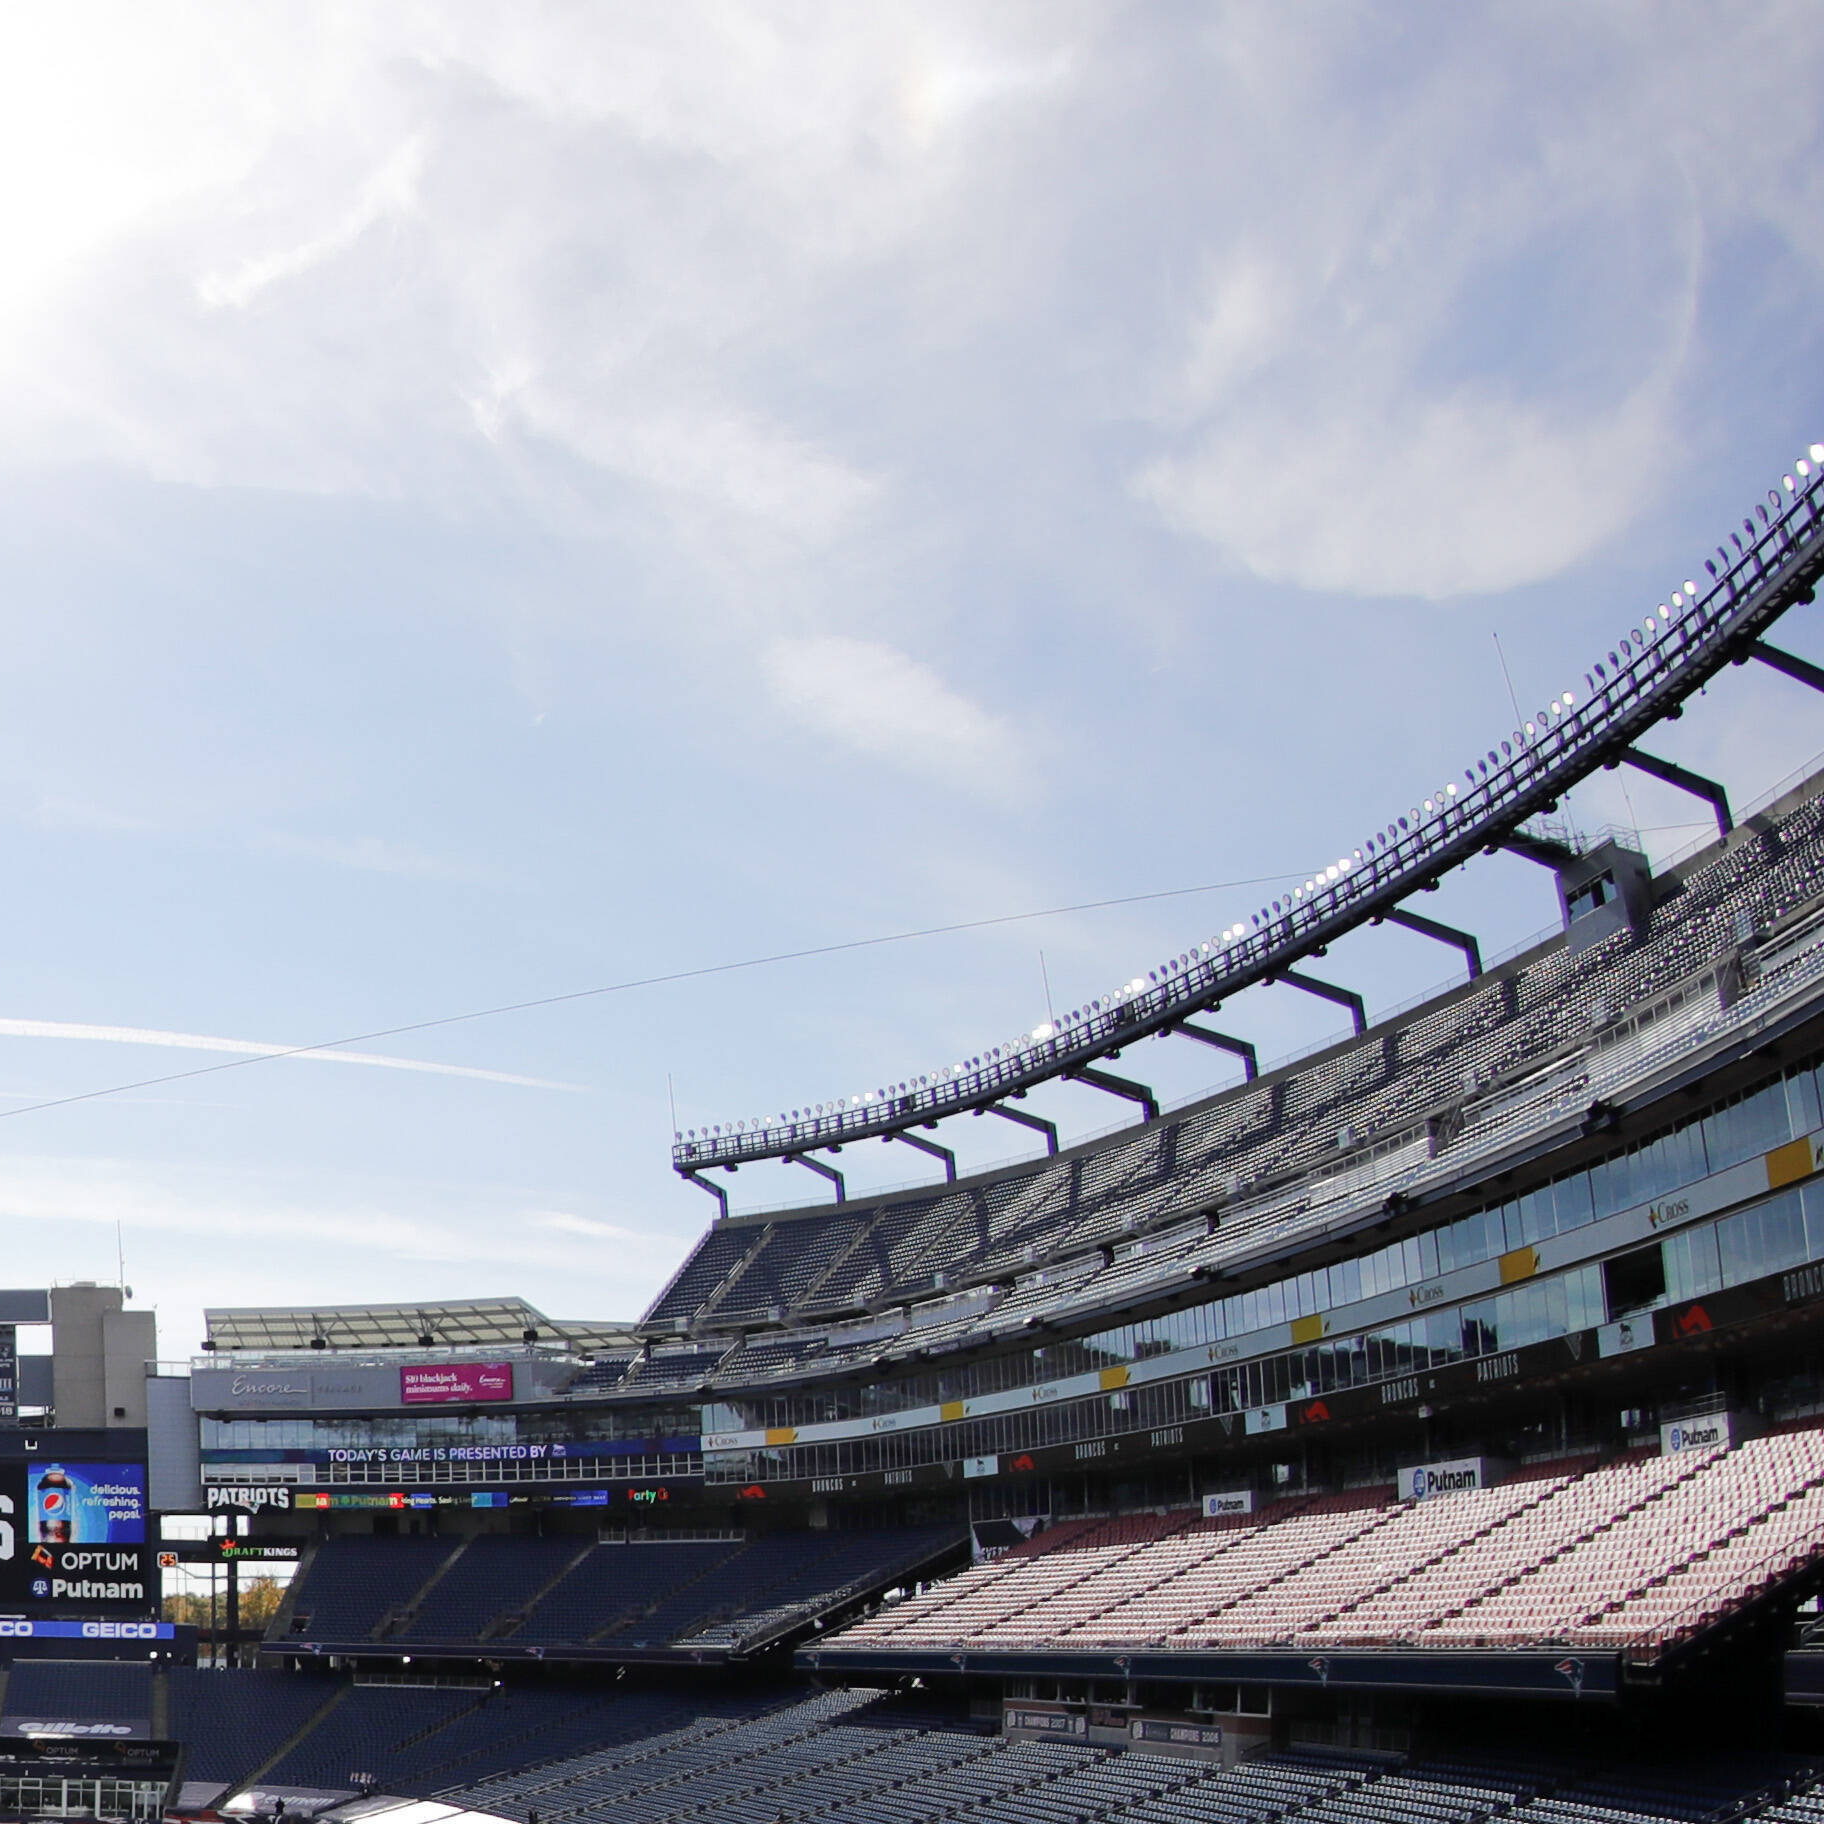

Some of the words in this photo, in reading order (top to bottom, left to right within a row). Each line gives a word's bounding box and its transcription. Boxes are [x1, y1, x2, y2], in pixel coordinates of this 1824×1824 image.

[232, 1374, 308, 1396] Encore
[1681, 1426, 1719, 1447] Putnam
[328, 1449, 387, 1462] TODAY'S
[391, 1449, 430, 1461] GAME
[433, 1448, 445, 1460] IS
[449, 1446, 526, 1460] PRESENTED
[529, 1445, 547, 1459] BY
[1427, 1469, 1476, 1493] Putnam
[90, 1484, 141, 1495] delicious.
[82, 1496, 141, 1508] refreshing.
[207, 1487, 290, 1509] PATRIOTS
[222, 1545, 297, 1558] DRAFTKINGS
[61, 1552, 138, 1571] OPTUM
[159, 1553, 176, 1567] 25
[52, 1579, 143, 1599] Putnam
[82, 1622, 157, 1638] GEICO
[17, 1721, 132, 1735] Gillette
[45, 1746, 80, 1756] OPTUM
[127, 1748, 160, 1758] OPTUM
